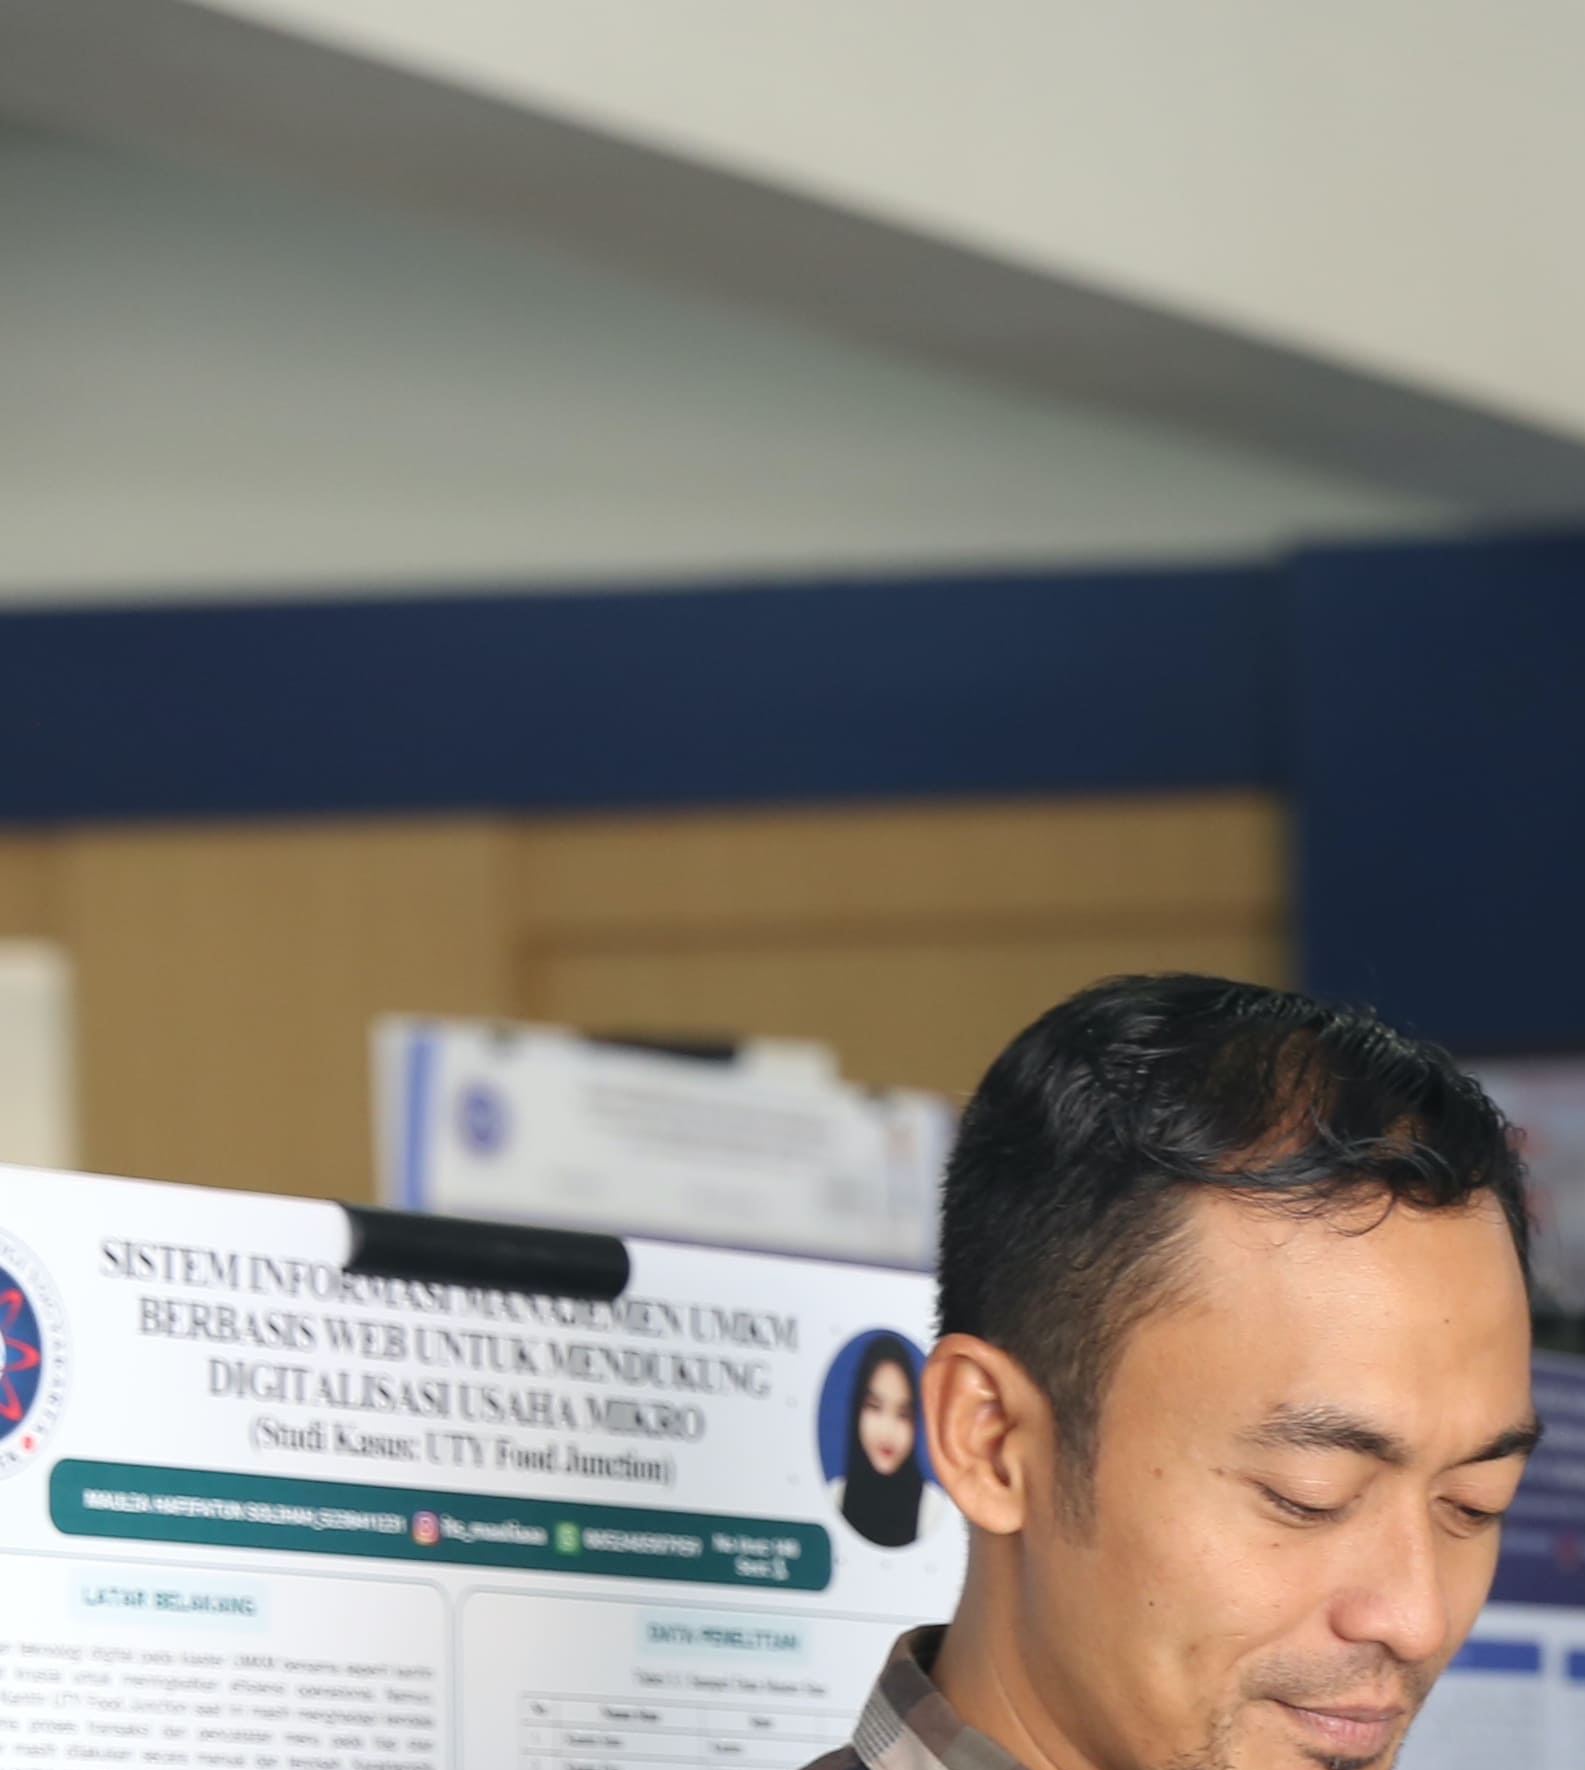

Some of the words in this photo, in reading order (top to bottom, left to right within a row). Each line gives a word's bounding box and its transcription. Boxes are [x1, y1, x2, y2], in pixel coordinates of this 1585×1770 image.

[138, 1297, 313, 1351] BERBASIS
[322, 1316, 407, 1360] WEB
[414, 1325, 538, 1375] UNTUK
[549, 1341, 772, 1398] MENDUKUNG
[208, 1358, 451, 1418] DIGITALISASI
[460, 1384, 572, 1430] USAHA
[587, 1396, 706, 1442] MIKRO
[422, 1428, 482, 1467] UTY
[491, 1435, 551, 1471] Food
